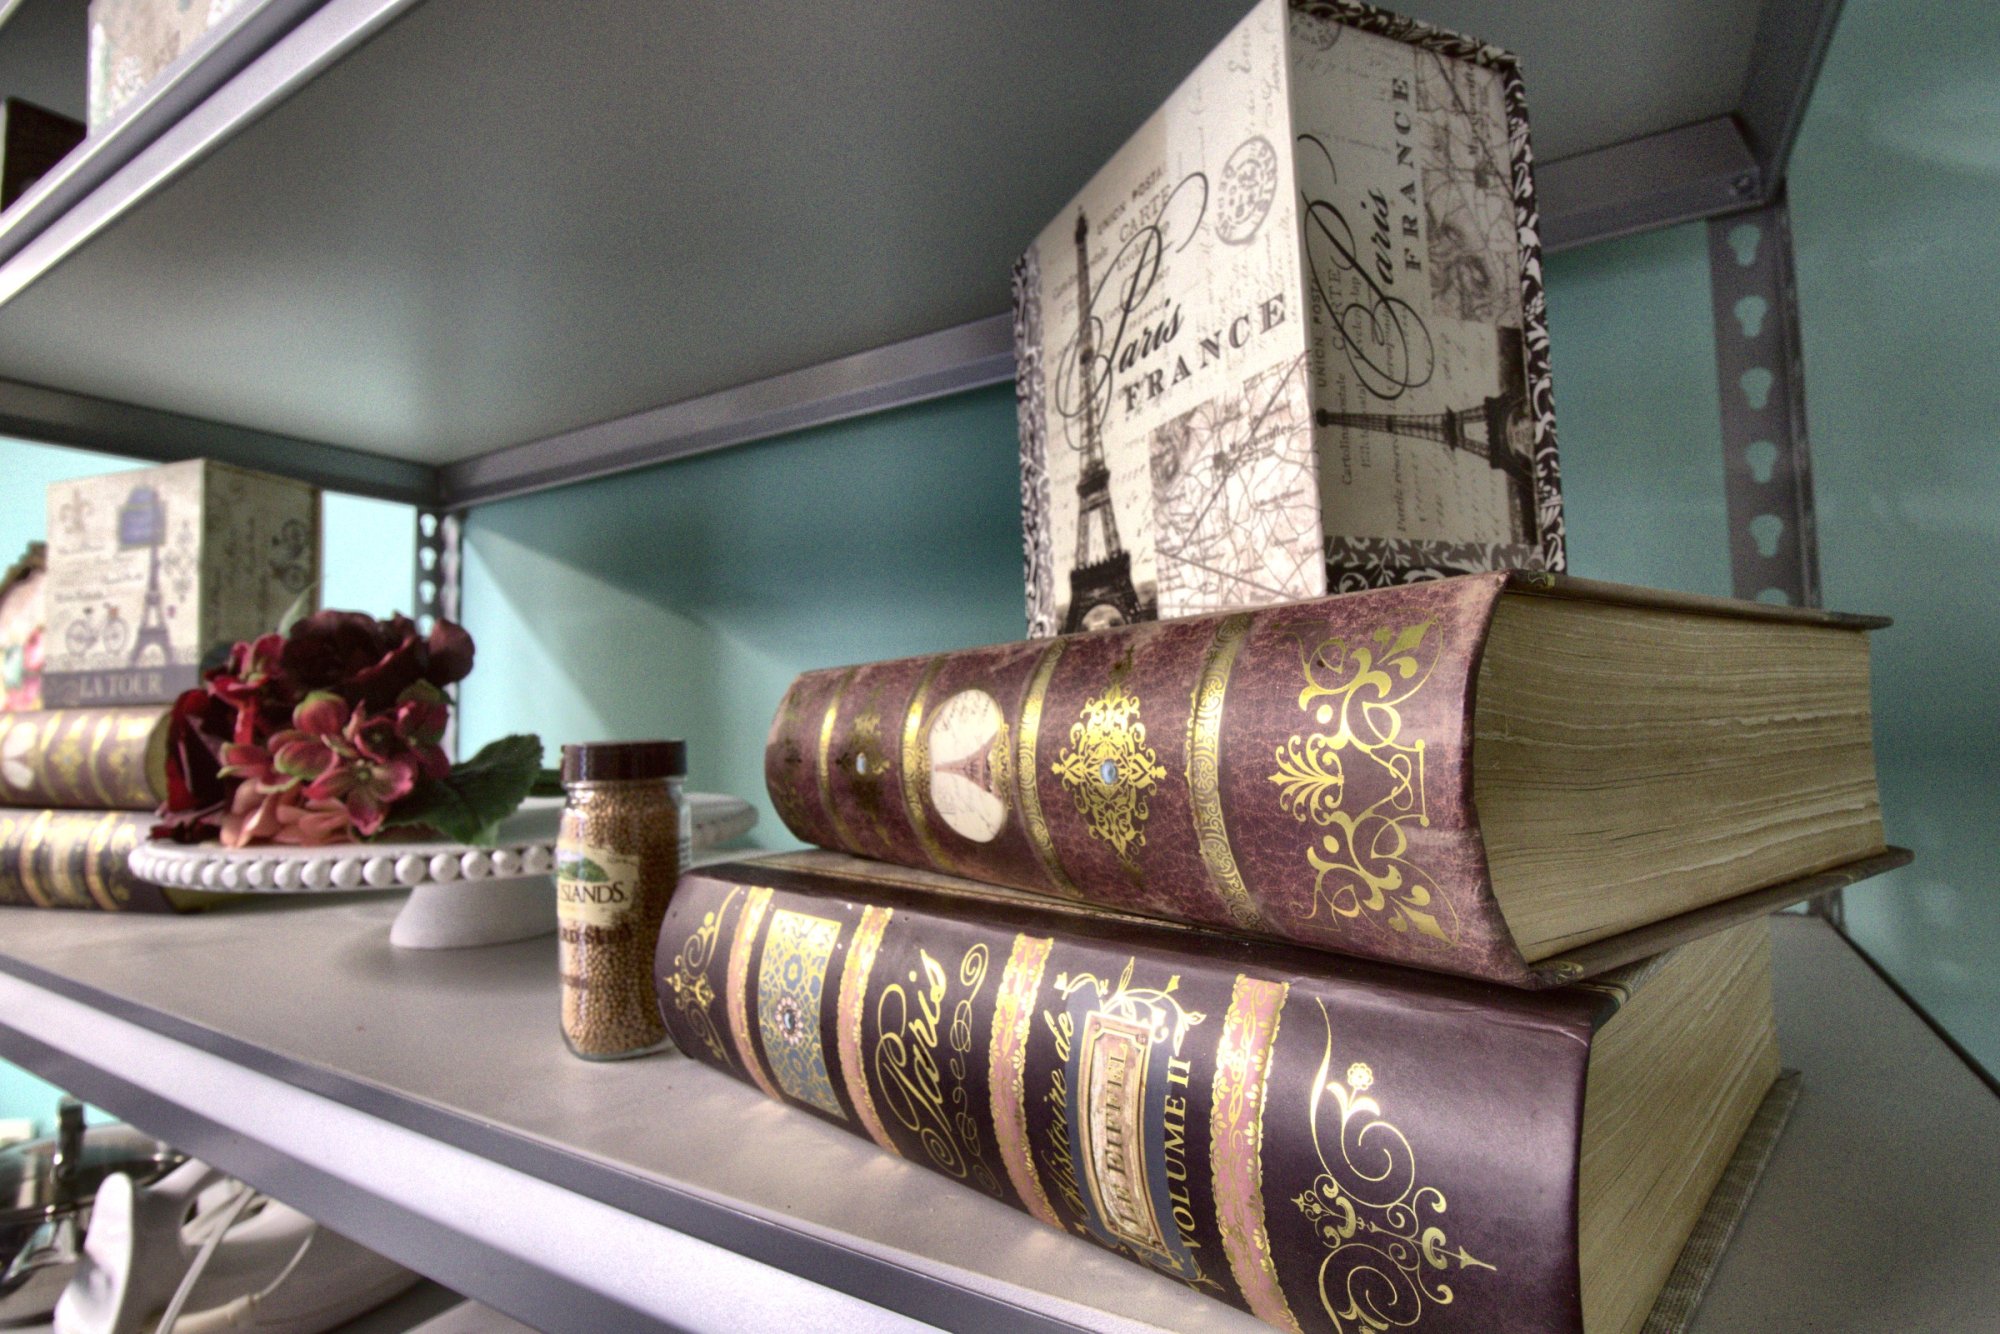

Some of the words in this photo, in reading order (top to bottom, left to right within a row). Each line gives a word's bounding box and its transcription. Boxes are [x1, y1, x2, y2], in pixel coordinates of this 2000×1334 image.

[1391, 77, 1422, 273] FRANCE
[1122, 292, 1287, 412] FRANCE
[1313, 336, 1328, 388] UNION
[106, 672, 163, 697] TOUR
[876, 948, 968, 1179] Paris
[1043, 1008, 1075, 1063] de
[1166, 1055, 1192, 1090] II
[1102, 1043, 1129, 1180] EIFFEL
[1163, 1096, 1197, 1249] VOLUME
